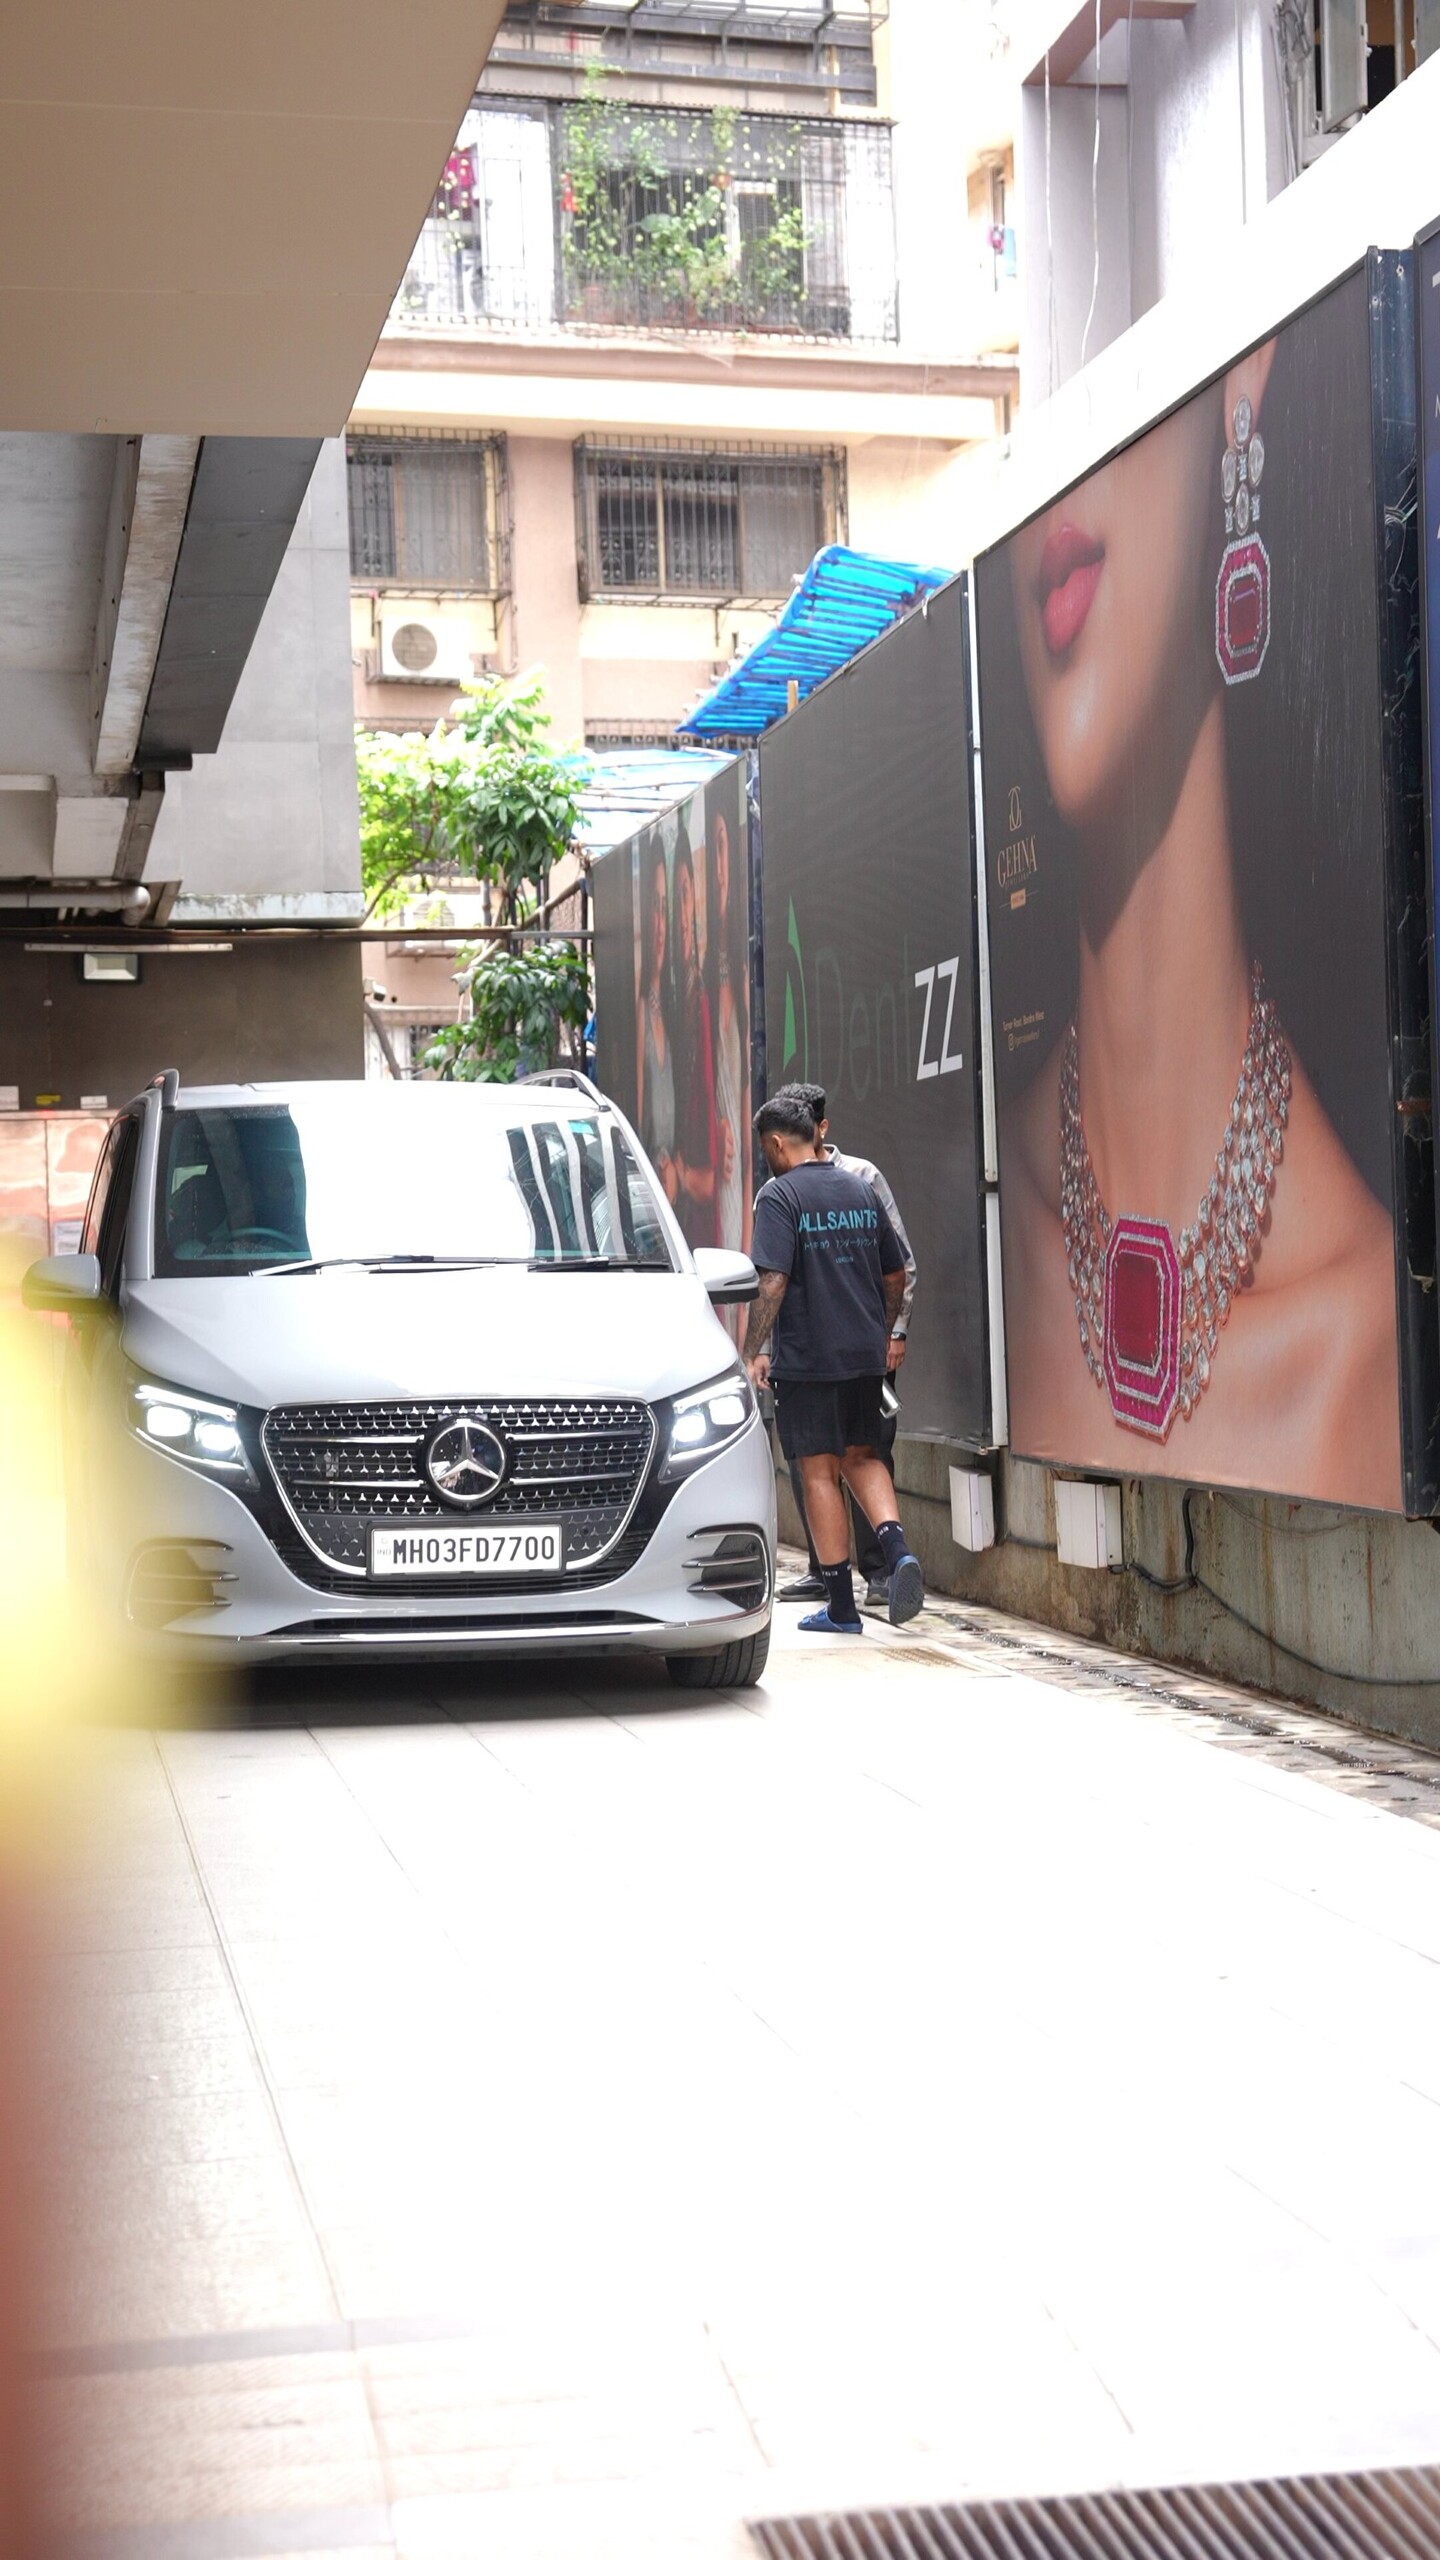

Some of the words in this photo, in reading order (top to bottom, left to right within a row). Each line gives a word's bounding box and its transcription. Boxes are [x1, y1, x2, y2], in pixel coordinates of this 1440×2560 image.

[997, 834, 1037, 888] GEHNA
[798, 1209, 878, 1233] ALLSAINTS
[393, 1535, 555, 1564] MH03FD7700
